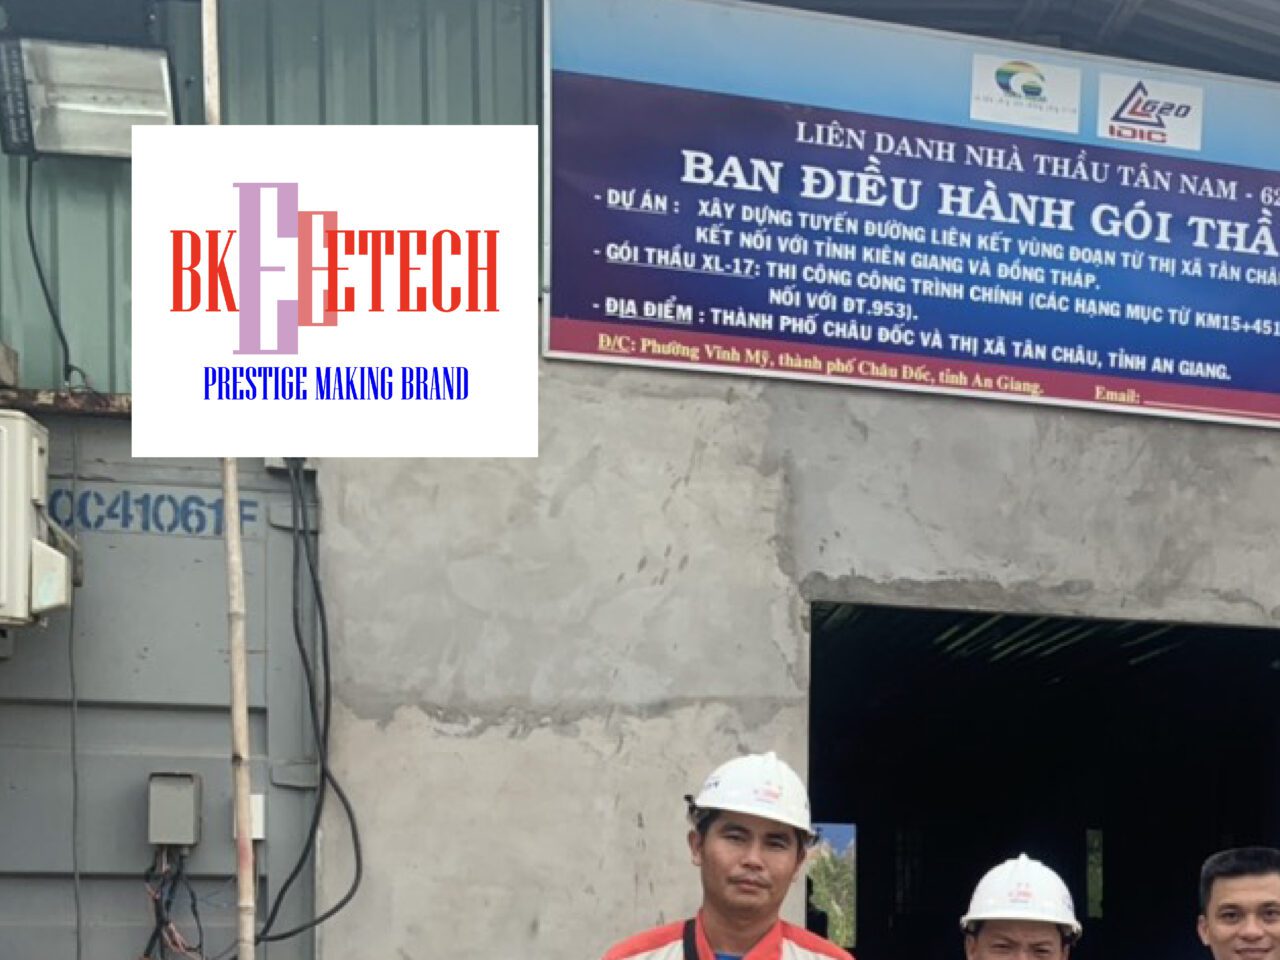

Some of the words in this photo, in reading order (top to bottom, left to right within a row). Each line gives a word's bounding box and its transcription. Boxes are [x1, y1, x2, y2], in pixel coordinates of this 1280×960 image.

[796, 119, 865, 150] LIÊN
[874, 131, 954, 162] DANH
[965, 144, 1024, 171] NHÀ
[1032, 149, 1108, 182] THẦU
[1117, 161, 1172, 191] TÂN
[1179, 174, 1237, 200] NAM
[1108, 123, 1166, 144] IDIC
[607, 188, 634, 210] DỰ
[698, 196, 733, 218] XÂY
[741, 205, 792, 226] DỰNG
[798, 211, 858, 234] TUYẾN
[863, 219, 925, 242] ĐƯỜNG
[931, 226, 970, 248] LIÊN
[977, 231, 1011, 252] KẾT
[1017, 238, 1064, 259] VÙNG
[1069, 245, 1115, 267] ĐOẠN
[1120, 249, 1144, 269] TỪ
[1148, 255, 1176, 276] THỊ
[1181, 257, 1202, 276] XÃ
[1208, 260, 1241, 281] TÂN
[681, 149, 783, 193] BAN
[800, 154, 921, 210] ĐIỀU
[937, 179, 1074, 230] HÀNH
[1090, 199, 1172, 243] GÓI
[606, 241, 638, 263] GÓI
[644, 243, 695, 268] THẦU
[702, 253, 760, 275] XL-17:
[802, 262, 851, 285] CÔNG
[856, 269, 905, 292] CÔNG
[910, 277, 964, 299] TRÌNH
[969, 284, 1023, 305] CHÍNH
[1028, 290, 1069, 312] (CÁC
[1074, 297, 1120, 317] HẠNG
[1126, 303, 1162, 323] MỤC
[1167, 305, 1190, 325] TỪ
[1195, 311, 1280, 336] KM15+451
[696, 223, 732, 245] KẾT
[739, 228, 771, 250] NỐI
[777, 234, 807, 255] VỚI
[813, 236, 856, 260] TỈNH
[862, 244, 905, 266] KIÊN
[910, 251, 962, 273] GIANG
[968, 256, 990, 276] VÀ
[997, 258, 1044, 283] ĐỒNG
[1049, 268, 1099, 289] THÁP.
[605, 297, 636, 318] ĐỊA
[710, 307, 772, 330] THÀNH
[779, 313, 818, 334] PHỐ
[822, 319, 871, 340] CHÂU
[877, 323, 914, 345] ĐỐC
[920, 328, 942, 348] VÀ
[949, 334, 978, 355] THỊ
[983, 335, 1005, 355] XÃ
[1012, 339, 1046, 359] TÂN
[1051, 344, 1101, 368] CHÂU,
[1108, 348, 1146, 370] TỈNH
[1151, 357, 1173, 373] AN
[1178, 360, 1230, 379] GIANG.
[769, 285, 799, 306] NỐI
[806, 290, 836, 310] VỚI
[842, 296, 917, 320] ĐT.953).
[598, 333, 635, 352] Đ/C:
[639, 337, 699, 360] Phường
[704, 343, 739, 361] Vĩnh
[744, 348, 774, 370] Mỹ,
[778, 352, 821, 370] thành
[826, 357, 856, 378] phố
[858, 360, 897, 377] Châu
[901, 364, 935, 384] Đốc,
[938, 368, 967, 385] tỉnh
[971, 372, 992, 388] An
[1094, 385, 1139, 403] Email:
